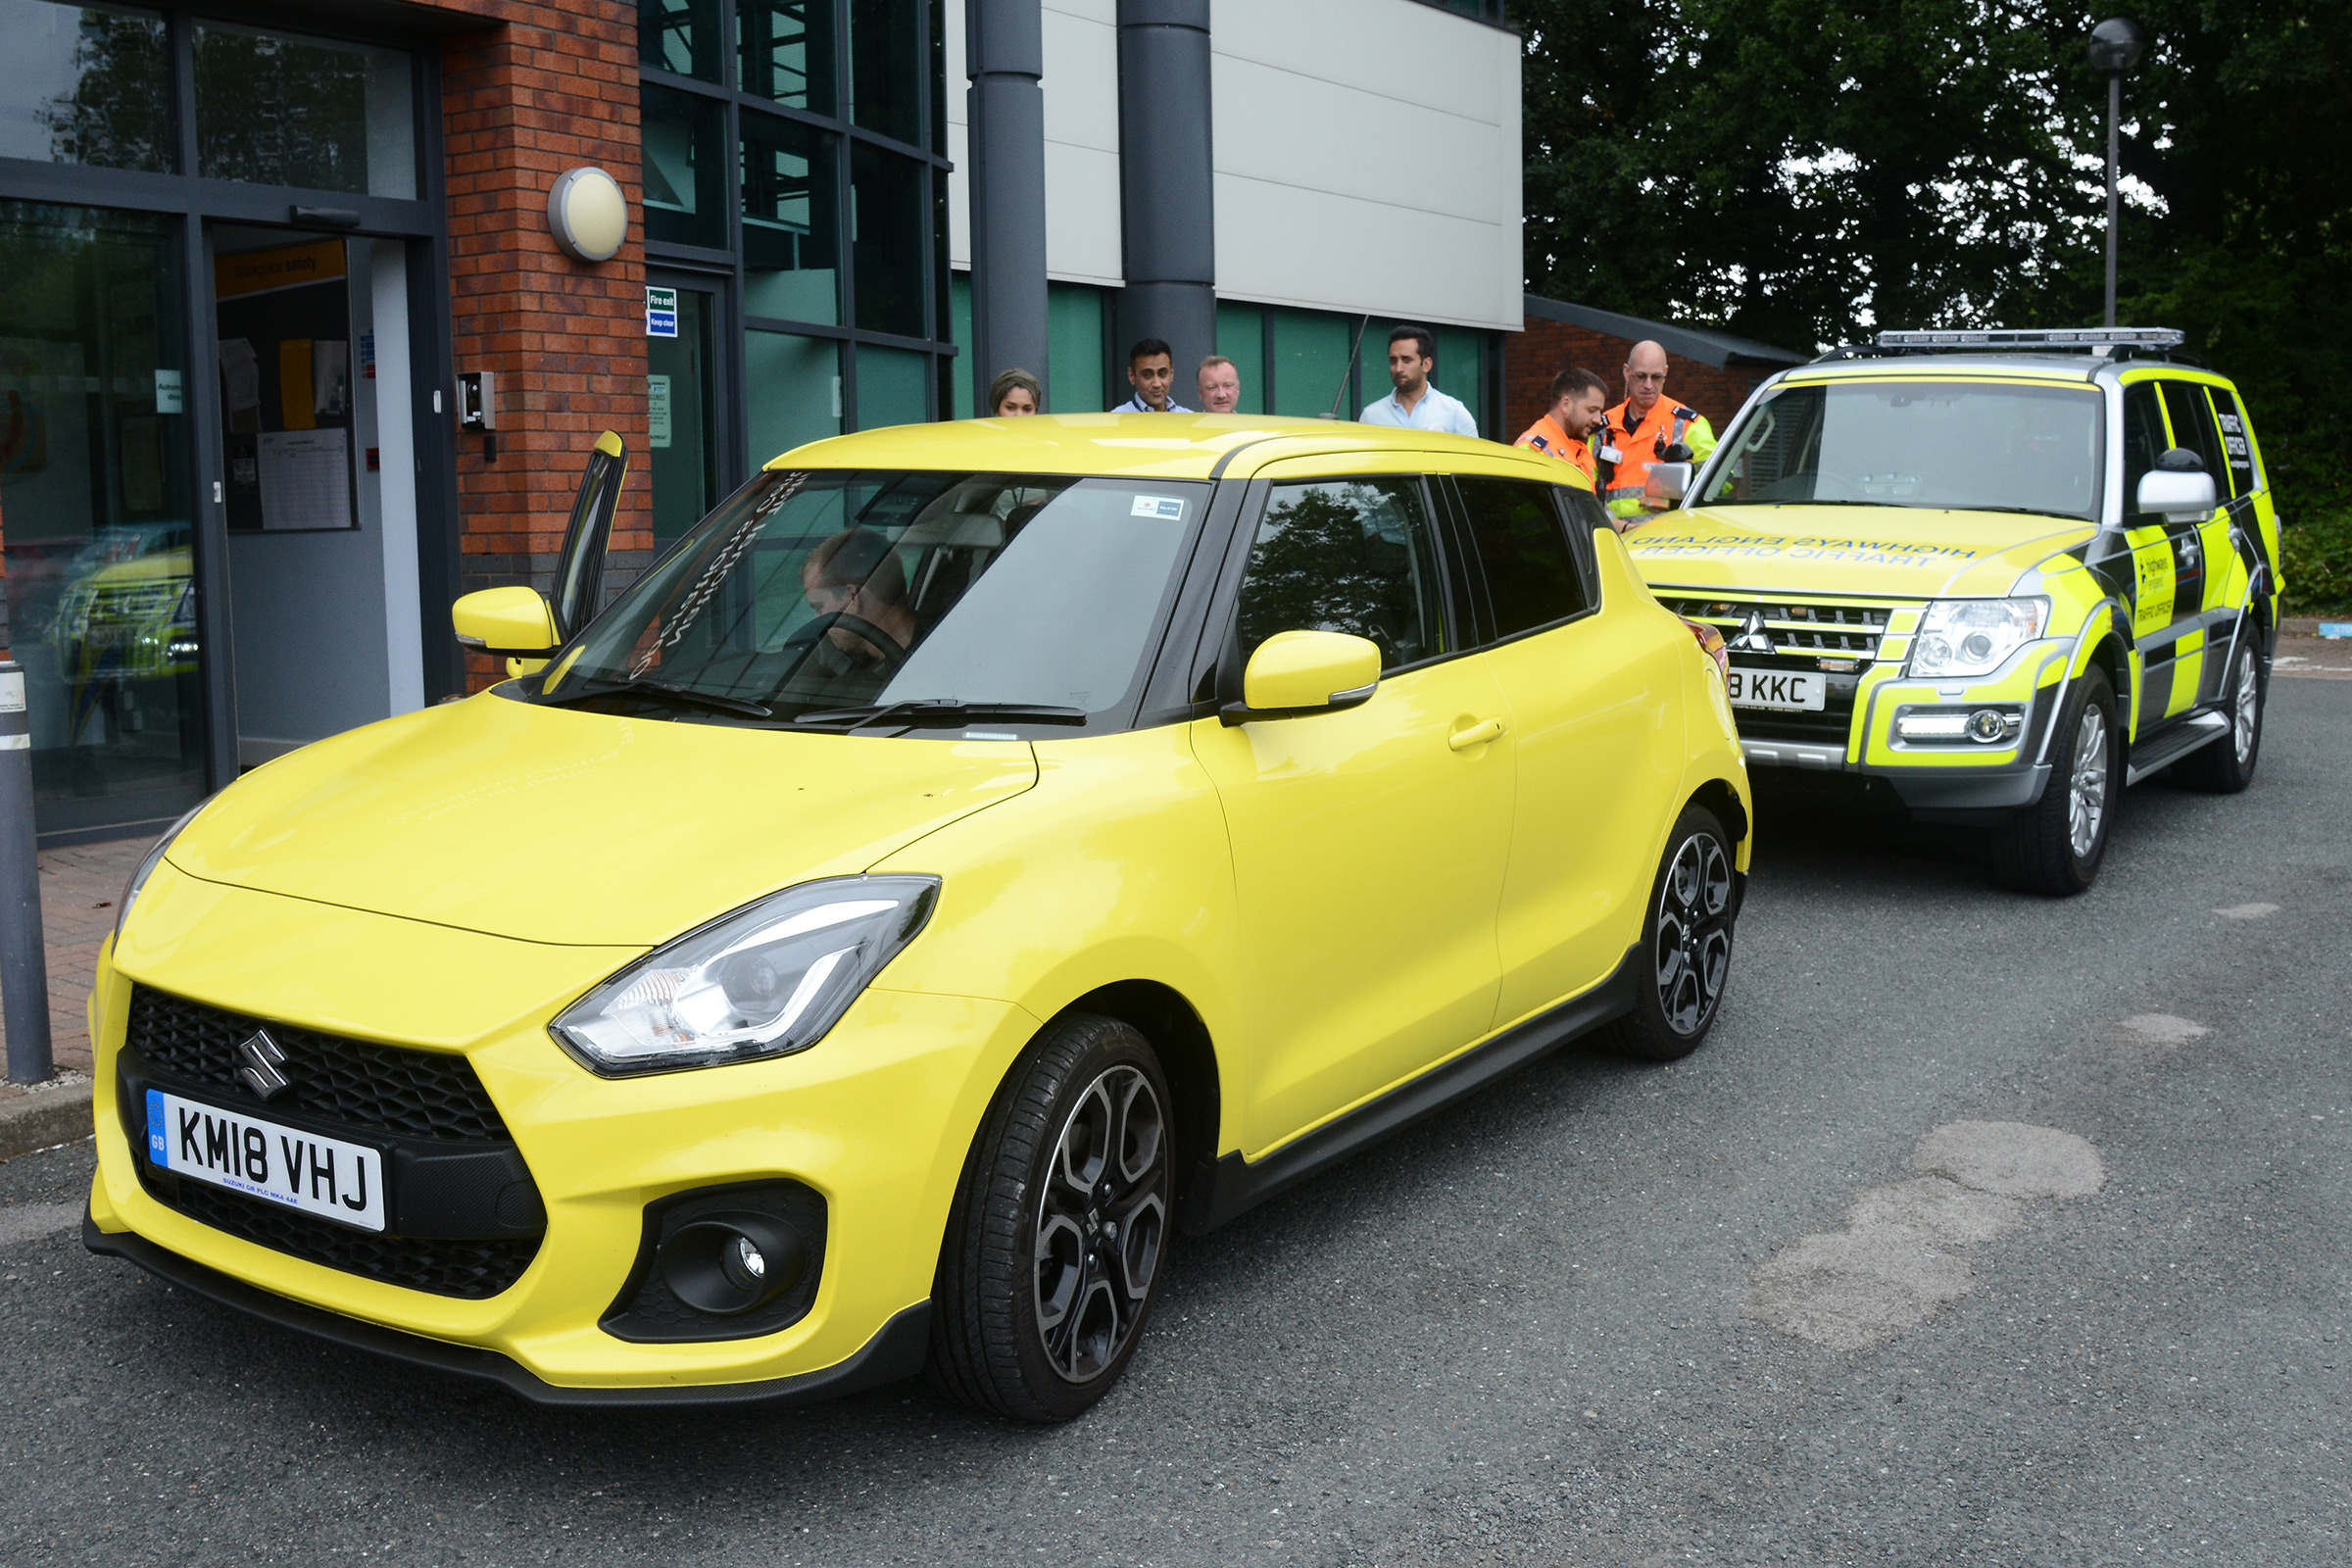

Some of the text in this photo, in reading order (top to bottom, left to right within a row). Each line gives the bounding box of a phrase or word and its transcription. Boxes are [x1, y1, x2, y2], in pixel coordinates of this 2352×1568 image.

[285, 256, 318, 272] safety
[650, 295, 674, 306] Fire exit
[651, 318, 662, 327] Keep
[1751, 674, 1807, 703] KKC
[151, 1134, 165, 1152] GB
[178, 1106, 368, 1212] KM18 VHJ
[222, 1177, 245, 1189] SUZUKI
[246, 1184, 256, 1193] GB
[257, 1187, 270, 1197] PLC
